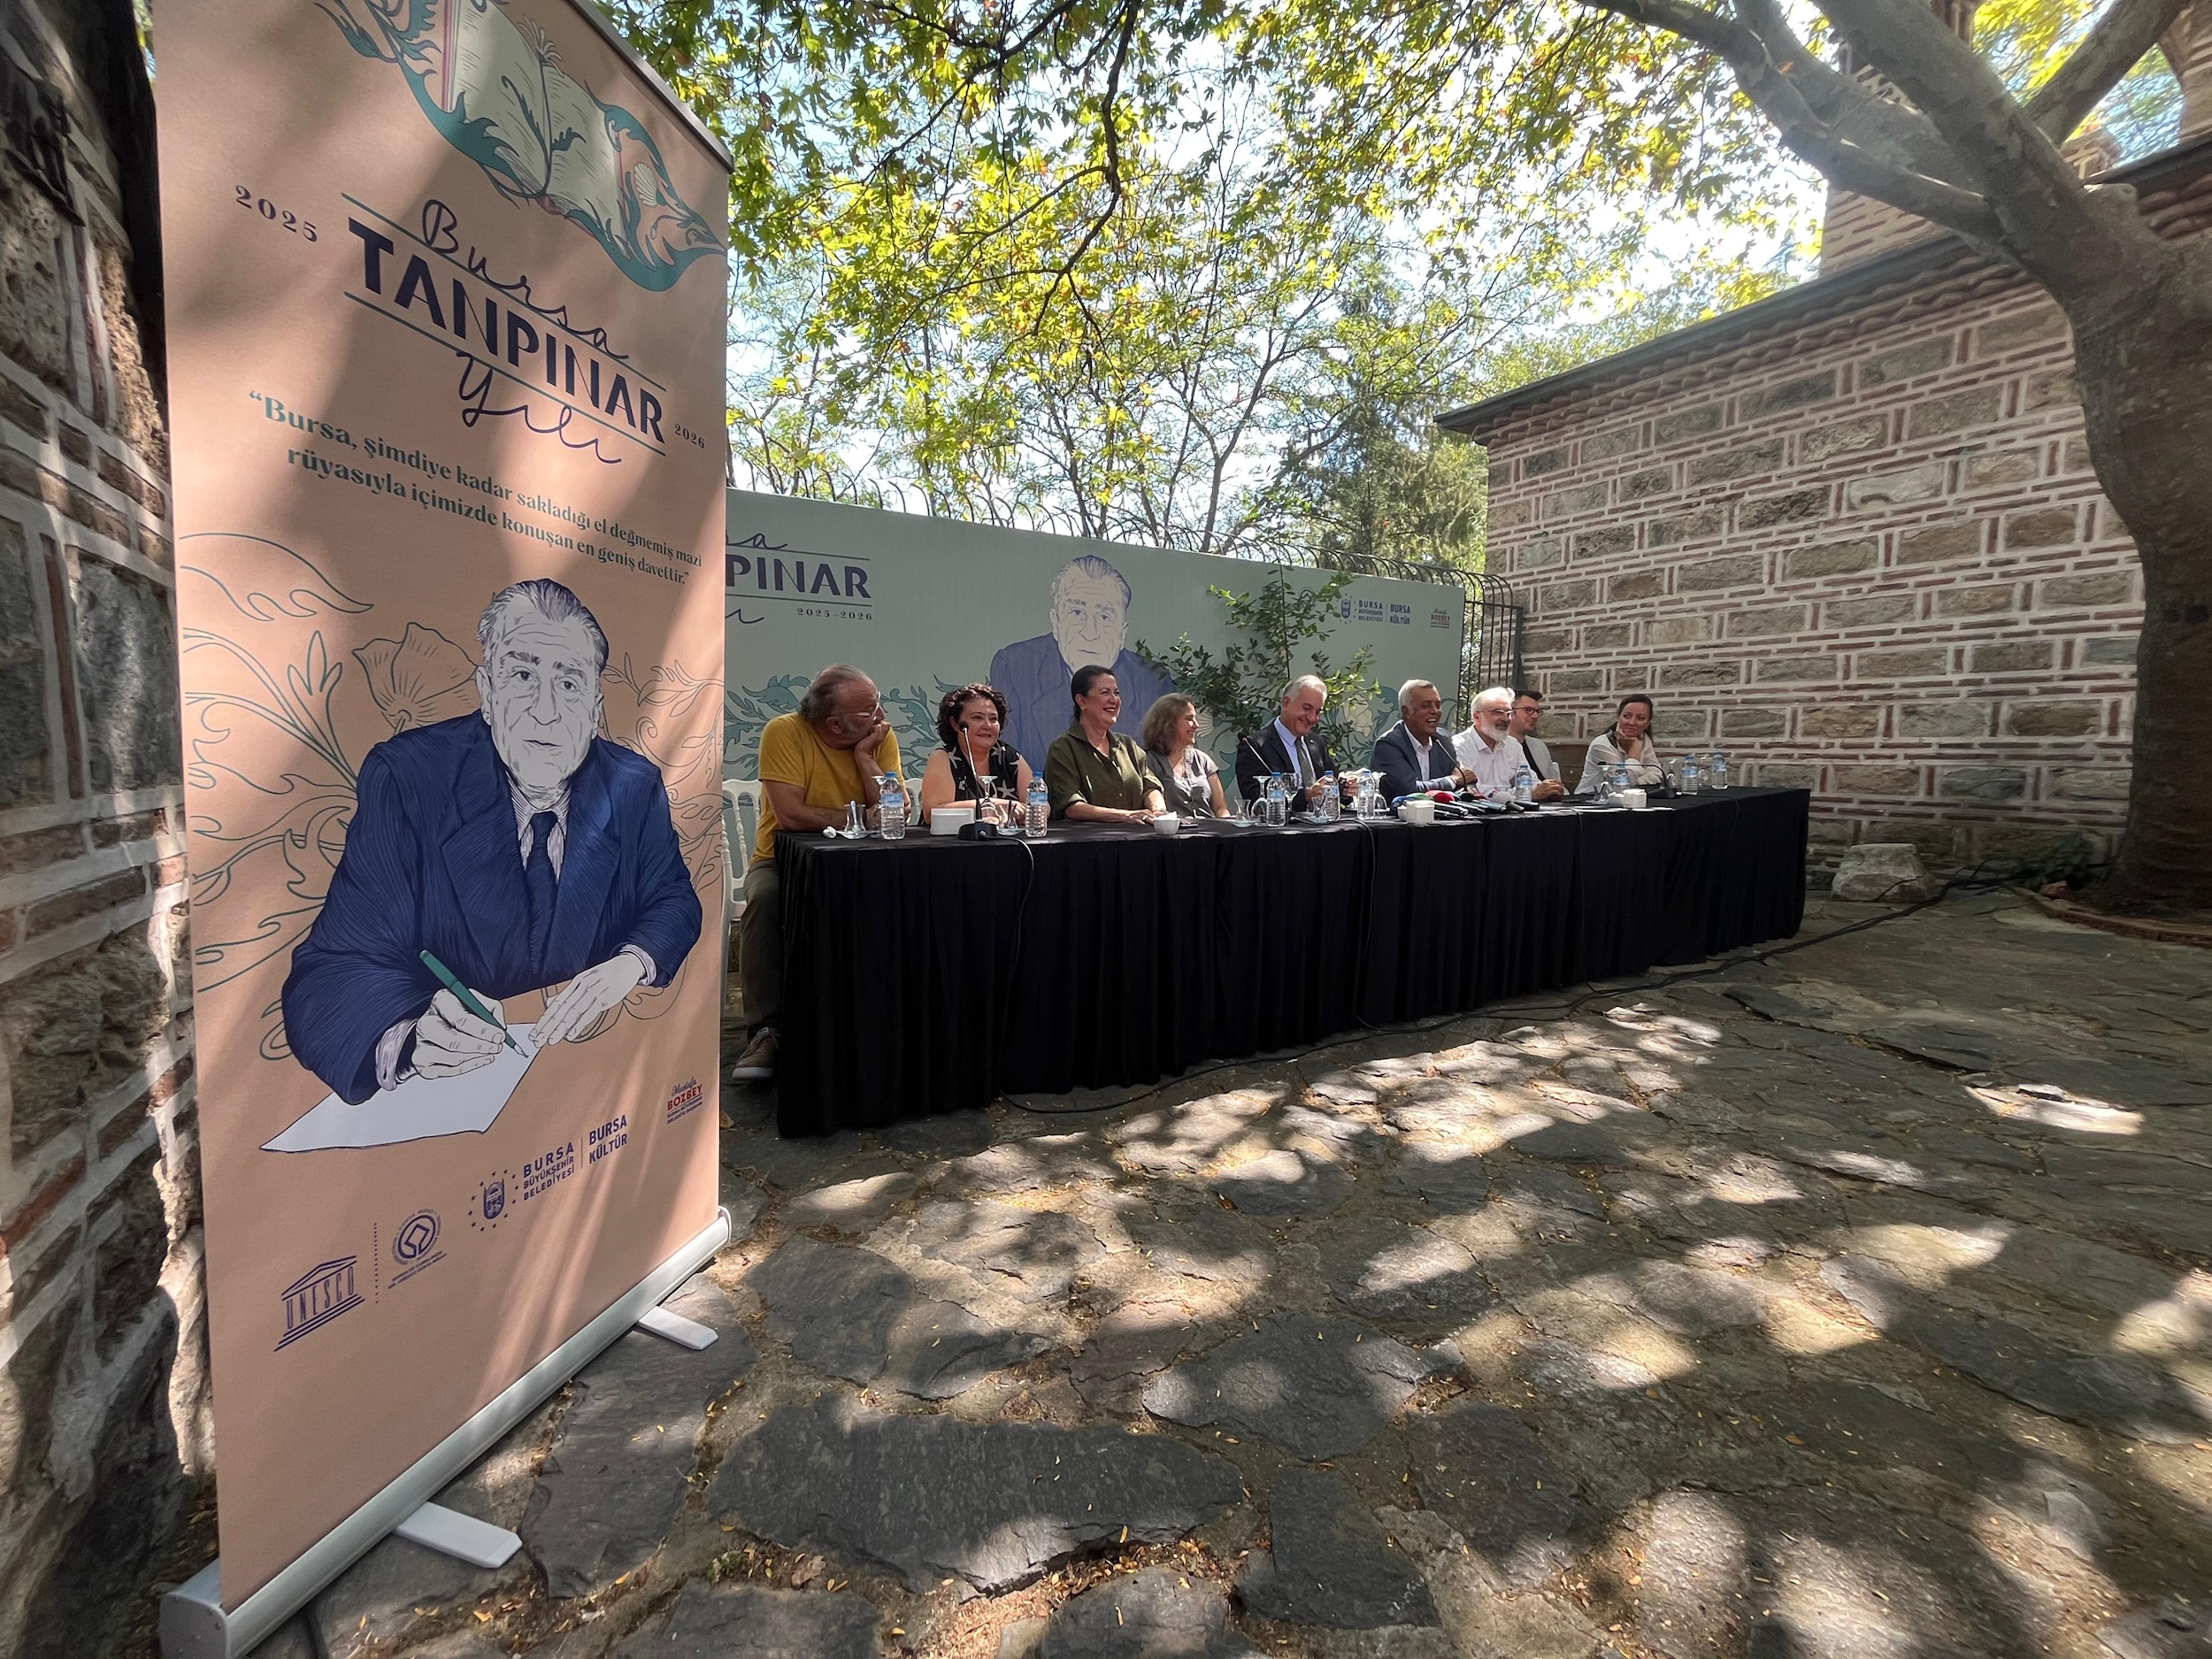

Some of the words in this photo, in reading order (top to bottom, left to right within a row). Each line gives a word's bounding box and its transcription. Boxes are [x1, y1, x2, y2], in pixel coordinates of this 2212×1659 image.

[235, 184, 319, 243] 2025
[422, 199, 629, 360] Bursa
[348, 217, 666, 444] TANPINAR
[674, 423, 706, 449] 2026
[249, 390, 357, 450] “Bursa,
[364, 437, 452, 480] şimdiye
[457, 465, 513, 501] kadar
[516, 492, 591, 530] sakladığı
[595, 518, 607, 534] el
[610, 523, 674, 560] değmemiş
[676, 550, 703, 567] mazi
[288, 449, 406, 495] rüyasıyla
[411, 482, 498, 526] içimizde
[502, 511, 573, 549] konuşan
[577, 541, 595, 556] en
[598, 547, 635, 569] geniş
[1358, 600, 1383, 610] BURSA
[1390, 603, 1411, 614] BURSA
[1390, 614, 1411, 625] KÜLTÜR
[667, 1083, 703, 1111] BOZBEY
[588, 1115, 627, 1146] BURSA
[589, 1133, 627, 1164] KÜLTÜR
[523, 1141, 574, 1179] BURSA
[523, 1156, 574, 1190] BÜYÜKŞEHİR
[523, 1164, 575, 1202] BELEDİYESİ
[287, 1265, 354, 1330] UNESCO
